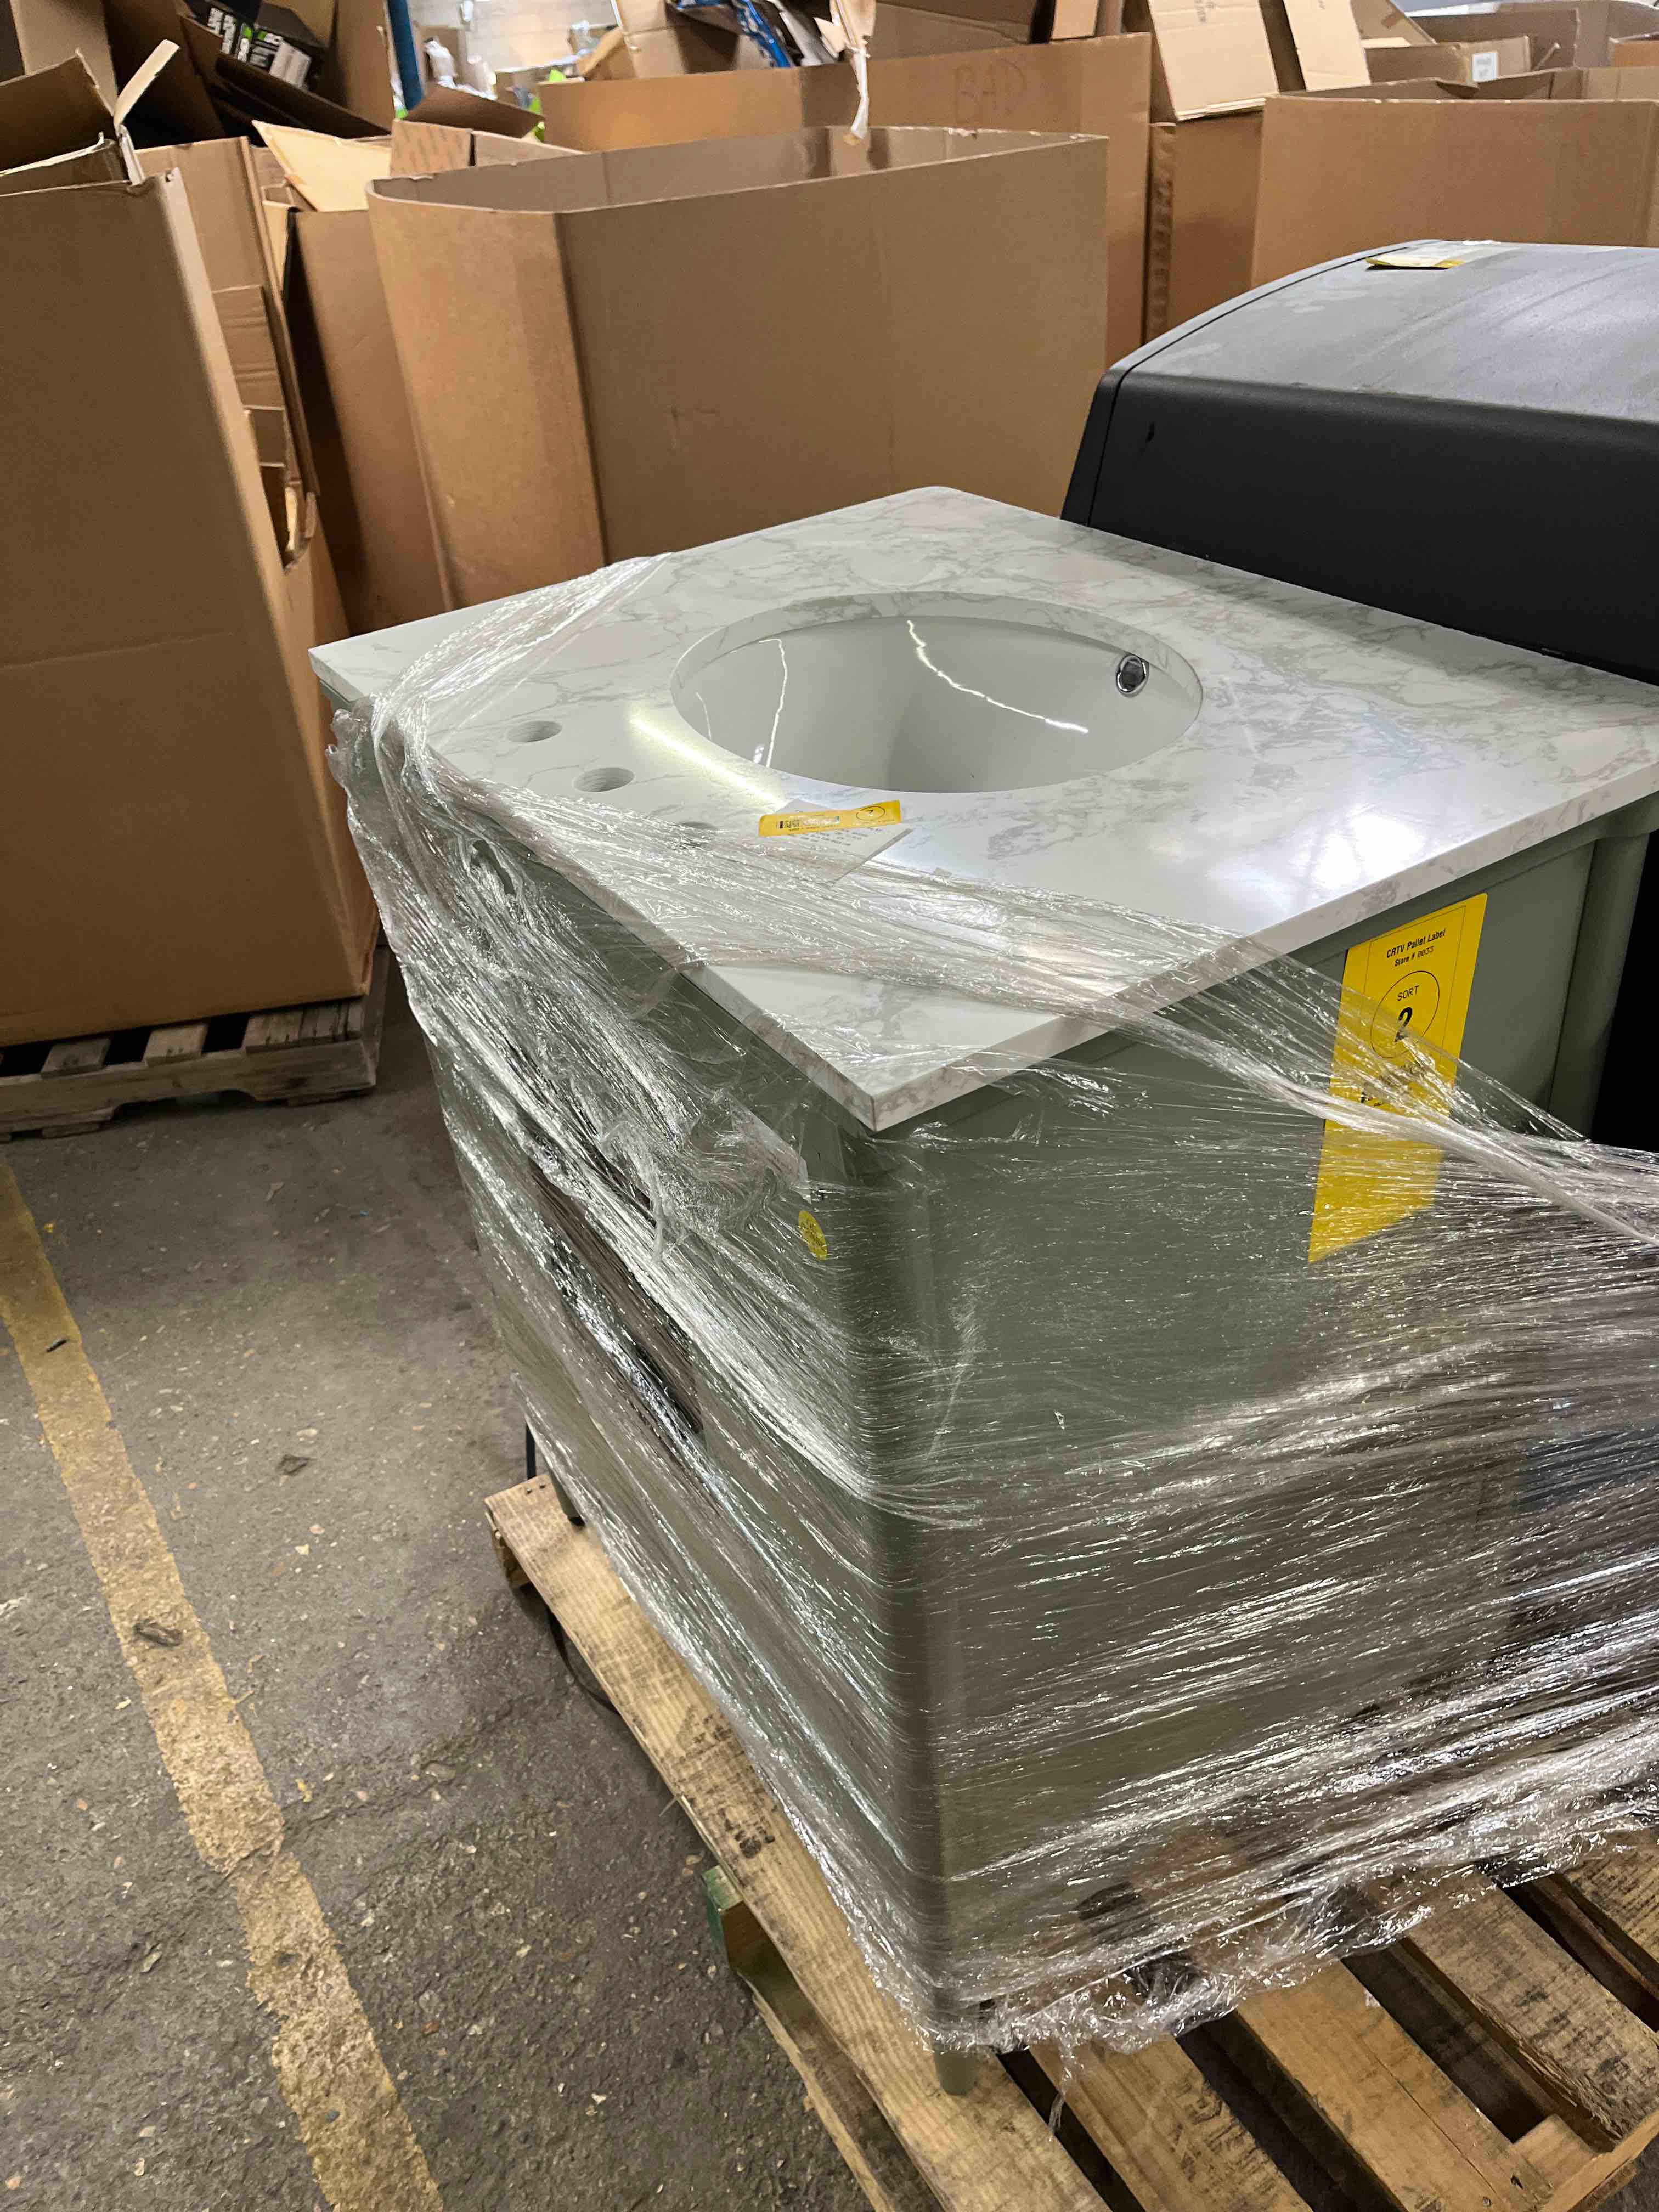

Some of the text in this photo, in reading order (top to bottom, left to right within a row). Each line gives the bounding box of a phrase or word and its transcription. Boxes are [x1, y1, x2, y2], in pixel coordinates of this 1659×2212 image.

[1386, 928, 1446, 958] CRTV Pallet Label
[1395, 956, 1409, 967] Store
[1397, 985, 1420, 1001] SORT
